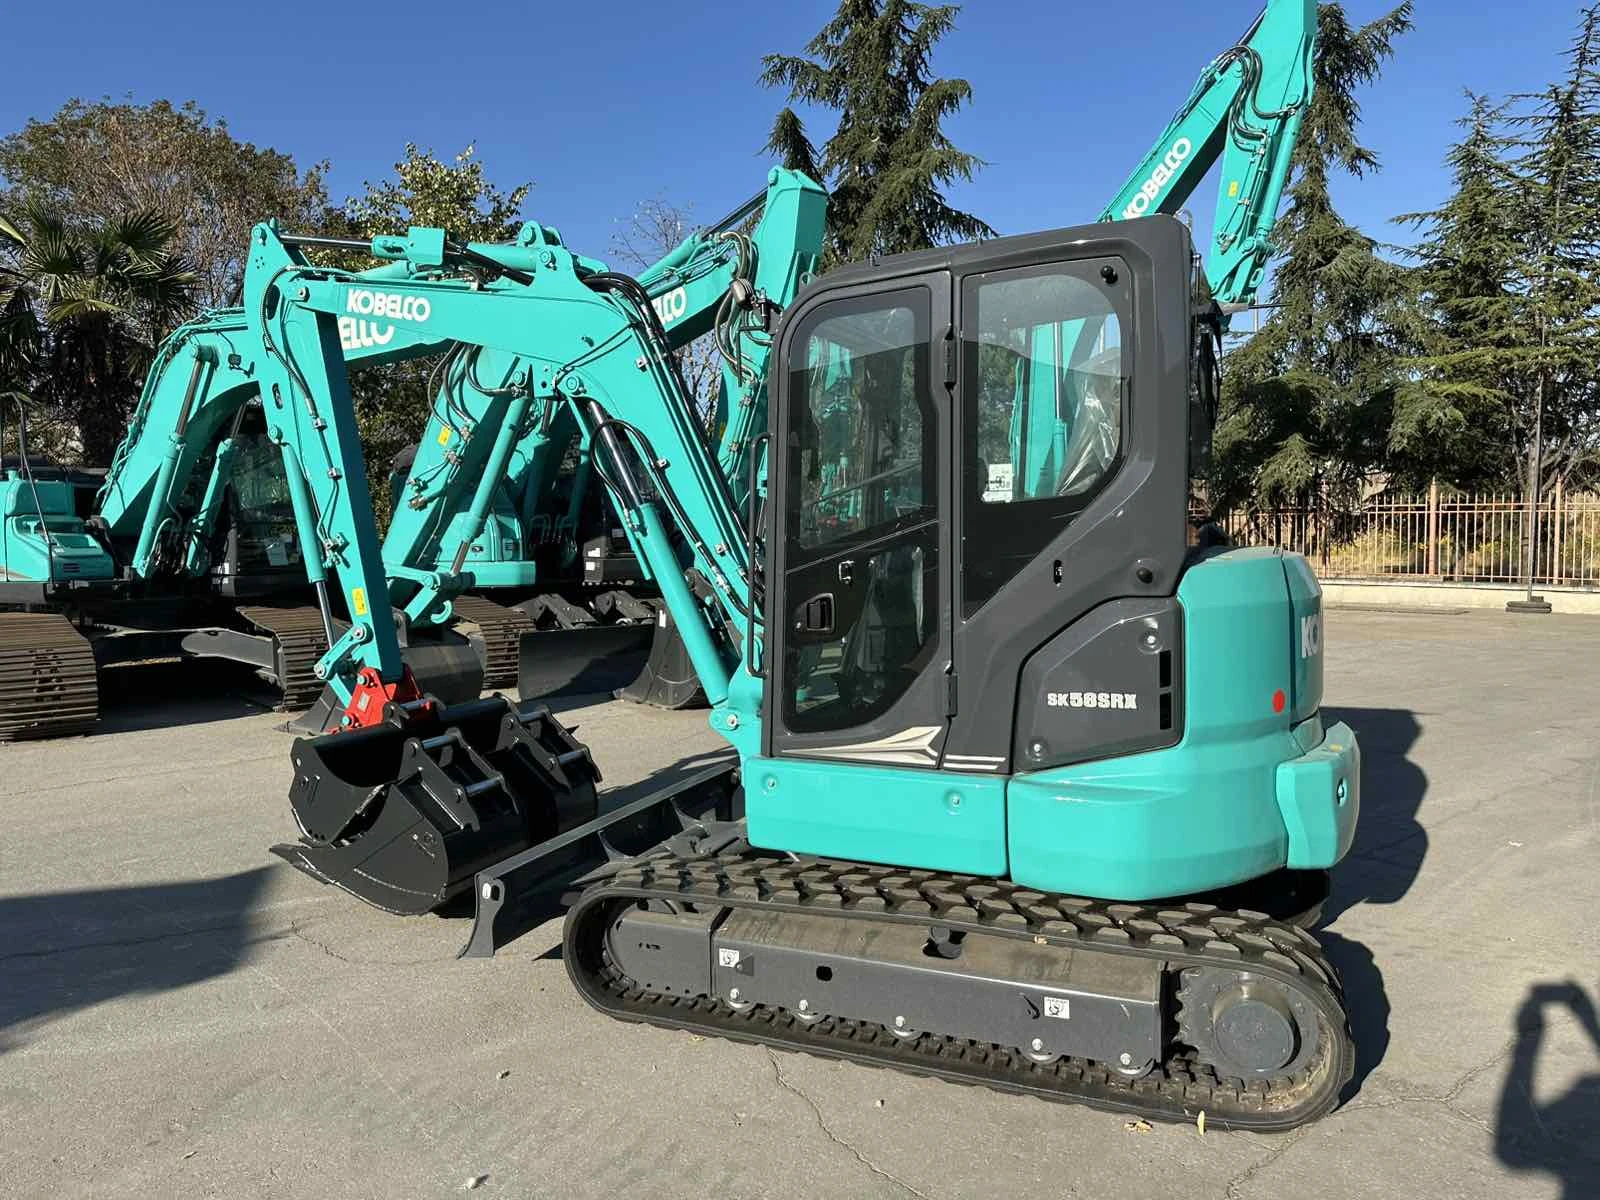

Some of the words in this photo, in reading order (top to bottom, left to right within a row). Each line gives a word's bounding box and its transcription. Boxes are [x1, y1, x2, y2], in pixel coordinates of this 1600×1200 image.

[1122, 137, 1191, 219] KOBELCO
[347, 288, 431, 322] KOBELCO
[1047, 692, 1137, 709] SK58SRX
